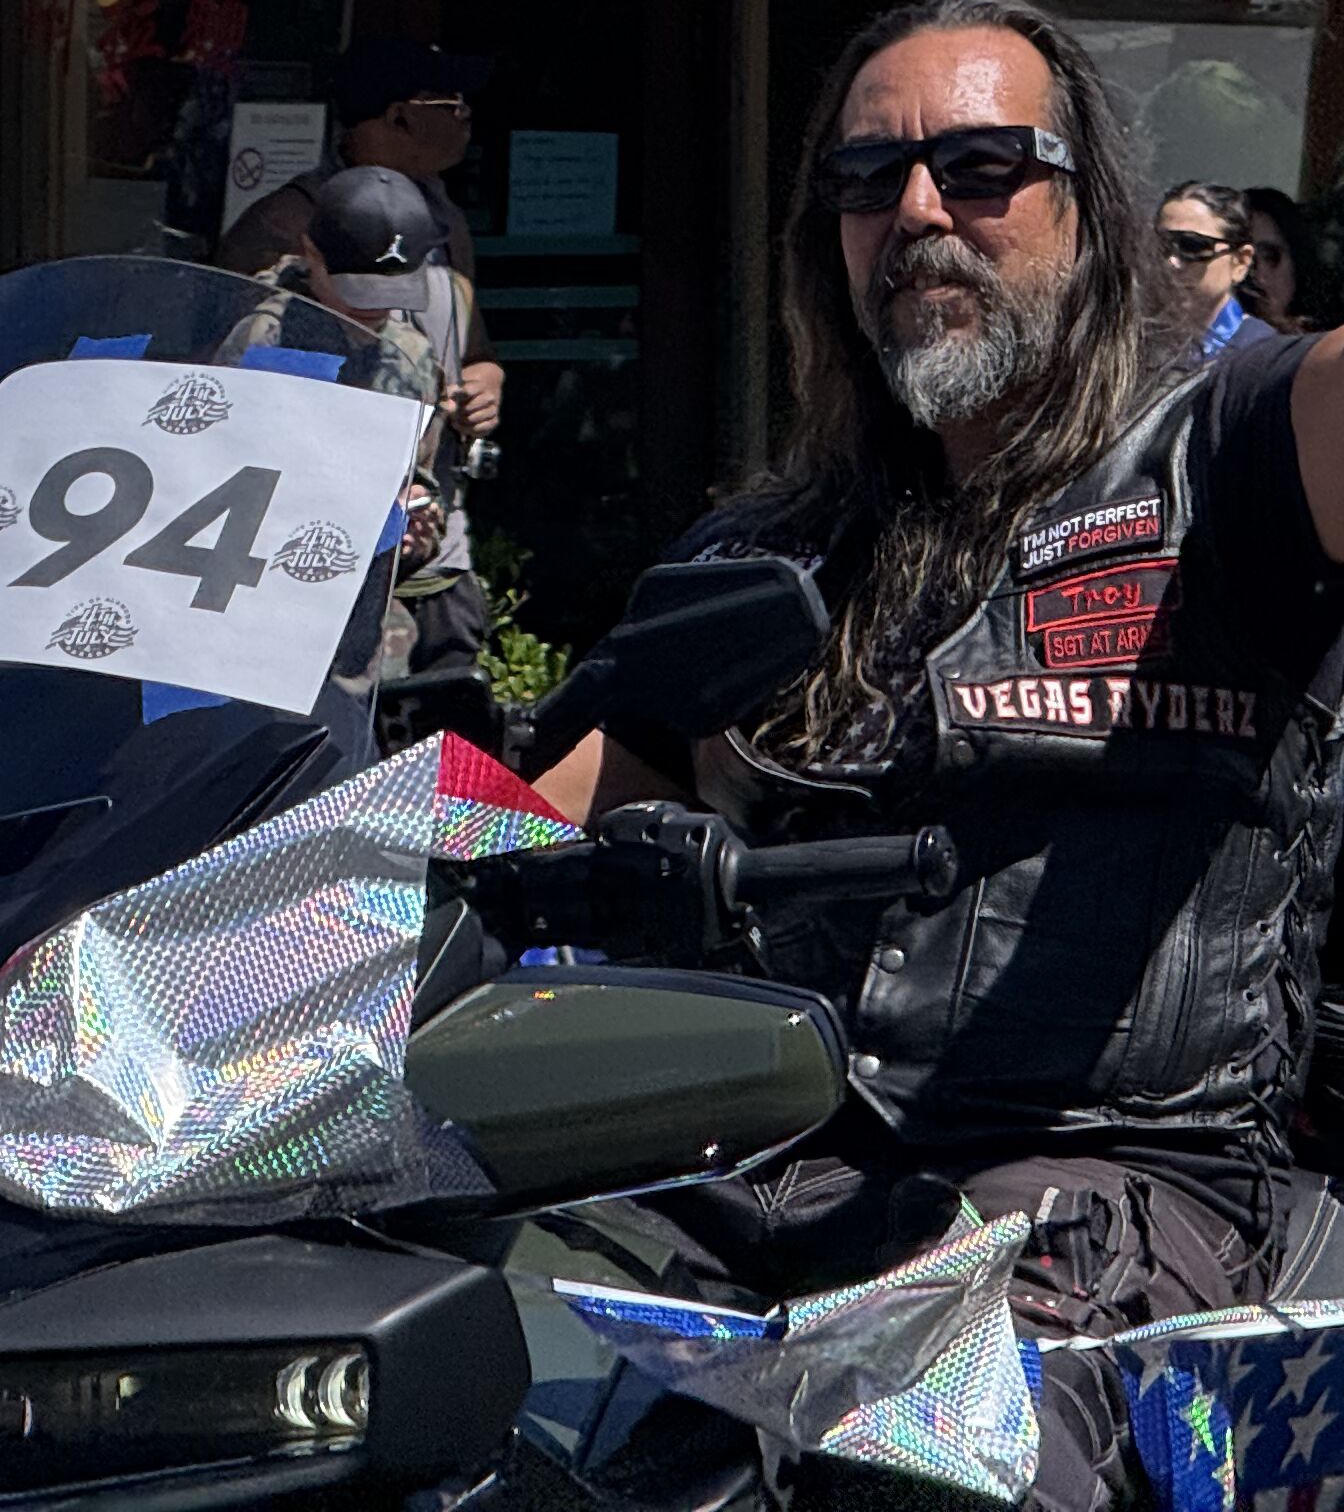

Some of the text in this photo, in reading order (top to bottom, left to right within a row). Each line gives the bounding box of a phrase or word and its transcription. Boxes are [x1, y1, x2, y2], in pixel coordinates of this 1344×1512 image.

[158, 402, 213, 423] JULY
[6, 446, 282, 615] 94
[1023, 498, 1161, 553] I'M NOT PERFECT
[286, 548, 340, 569] JULY
[1022, 518, 1160, 570] JUST FORGIVEN
[1061, 582, 1142, 615] Troy
[63, 627, 117, 646] JULY
[1053, 633, 1087, 658] SGT
[1090, 629, 1112, 655] AT
[955, 676, 1258, 739] VEGAS RYDERZ
